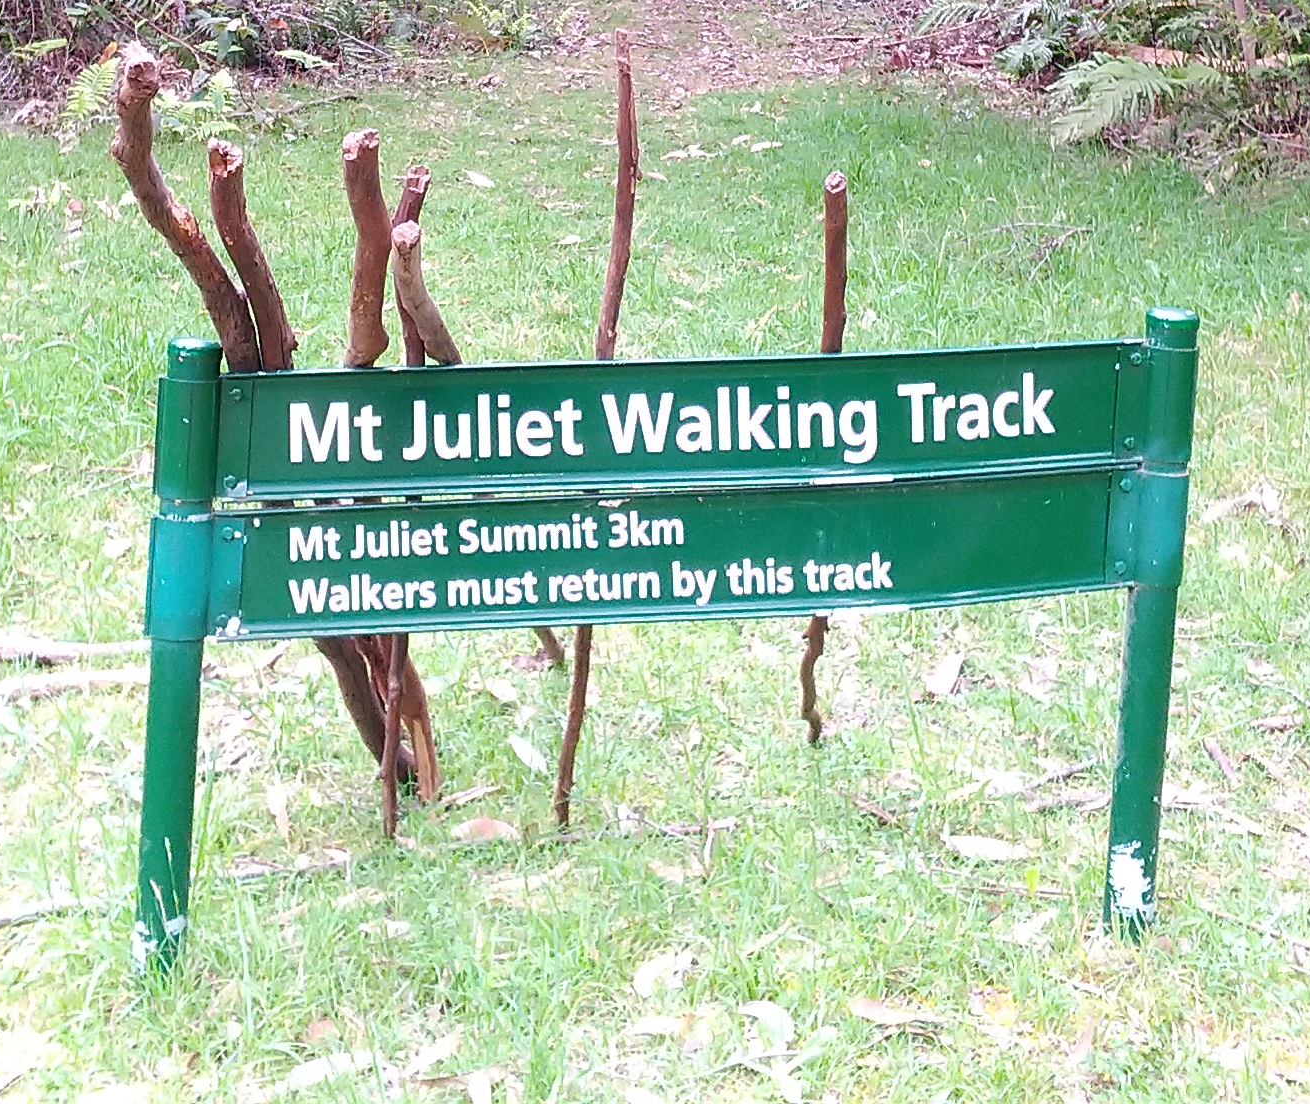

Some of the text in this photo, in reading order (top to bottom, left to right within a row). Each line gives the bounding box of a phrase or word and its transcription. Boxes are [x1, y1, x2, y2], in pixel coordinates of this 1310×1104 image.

[289, 372, 1056, 465] Mt Juliet Walking Track
[289, 510, 685, 563] Mt Juliet Summit 3km
[288, 551, 894, 615] Walkers must return by this track
